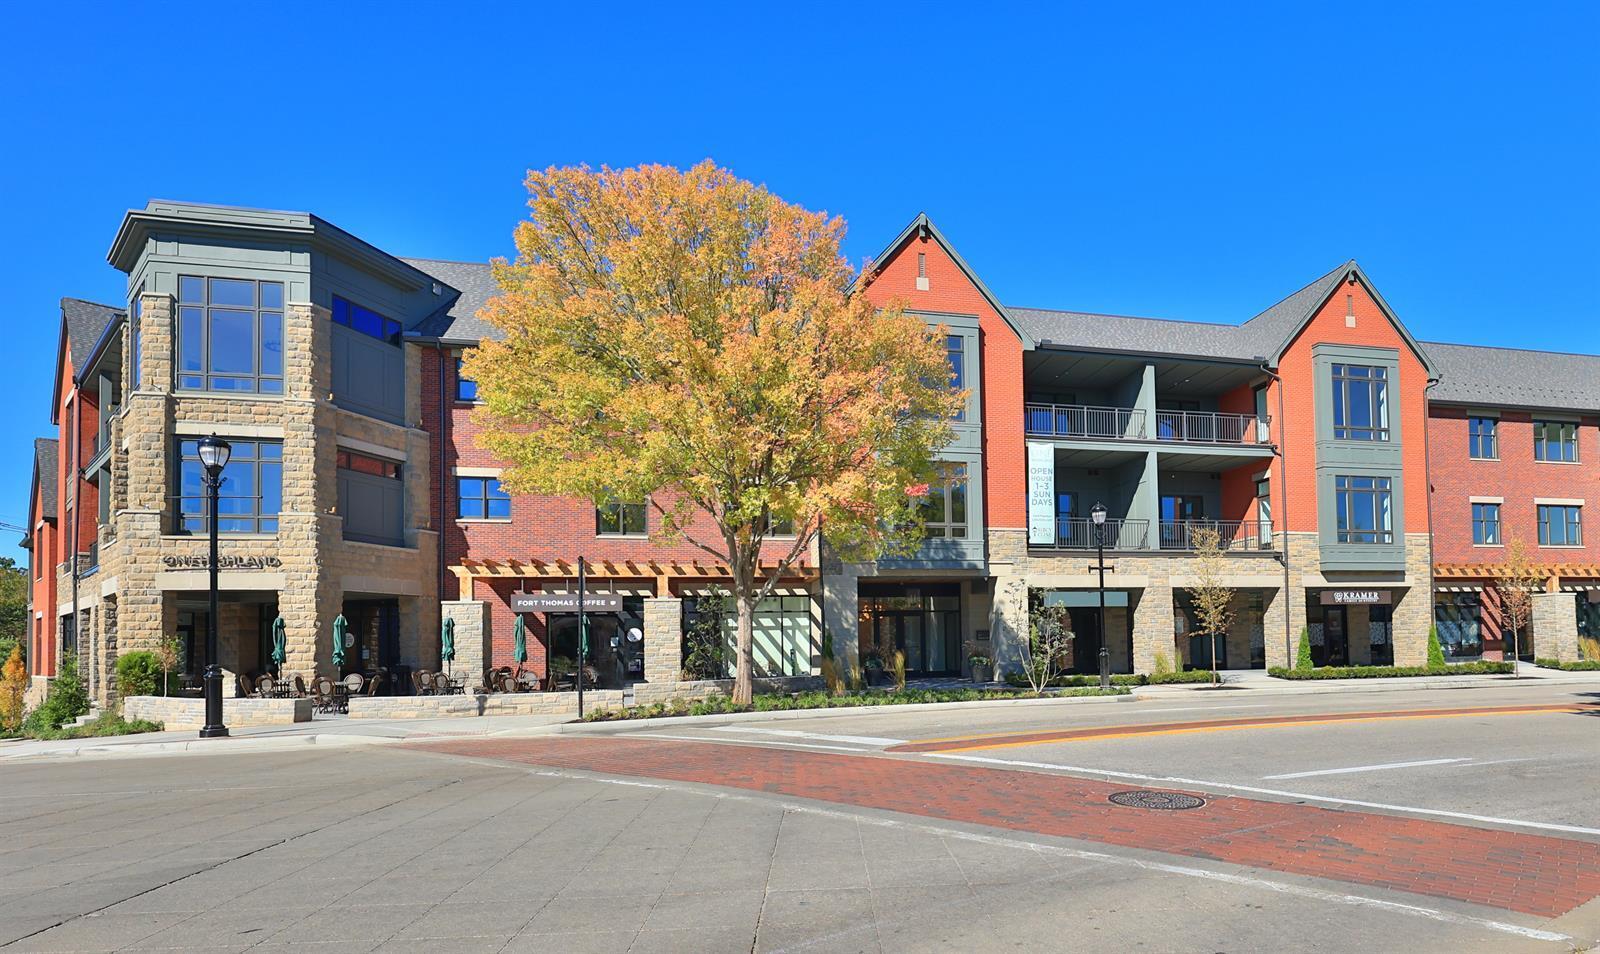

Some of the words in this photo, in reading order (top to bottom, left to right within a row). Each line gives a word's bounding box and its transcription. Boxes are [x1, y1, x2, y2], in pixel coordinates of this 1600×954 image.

[1035, 482, 1050, 490] 1-3
[1031, 498, 1053, 506] DAYS
[1343, 591, 1380, 600] KRAMER
